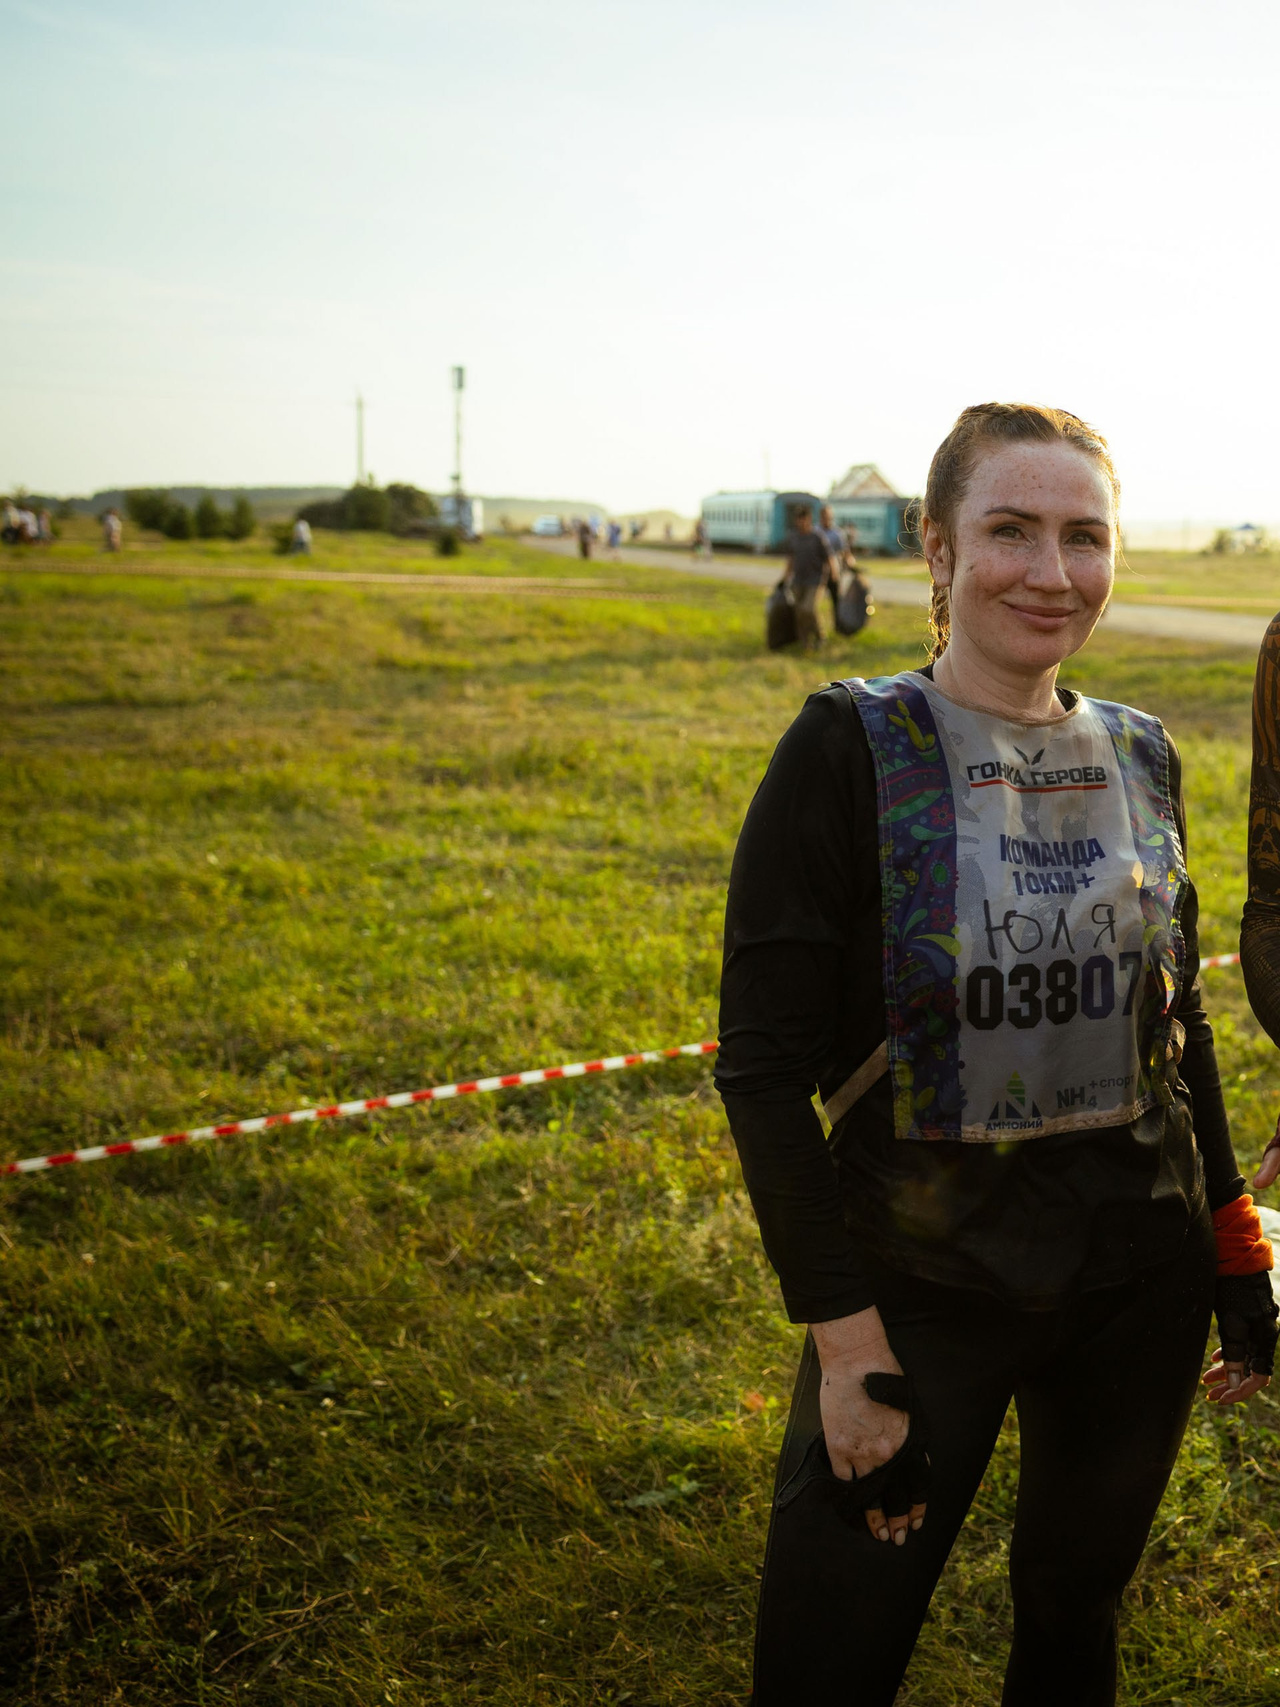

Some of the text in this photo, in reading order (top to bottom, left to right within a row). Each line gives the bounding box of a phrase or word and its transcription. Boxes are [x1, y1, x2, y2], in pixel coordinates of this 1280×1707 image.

[966, 761, 1107, 786] ГОНКА ГЕРОЕВ
[1000, 834, 1106, 869] КОМАНДА
[1012, 870, 1095, 896] 10КМ+
[983, 899, 1116, 960] ЮЛЯ
[966, 951, 1142, 1031] 03807
[985, 1117, 1043, 1132] АММОНИЙ
